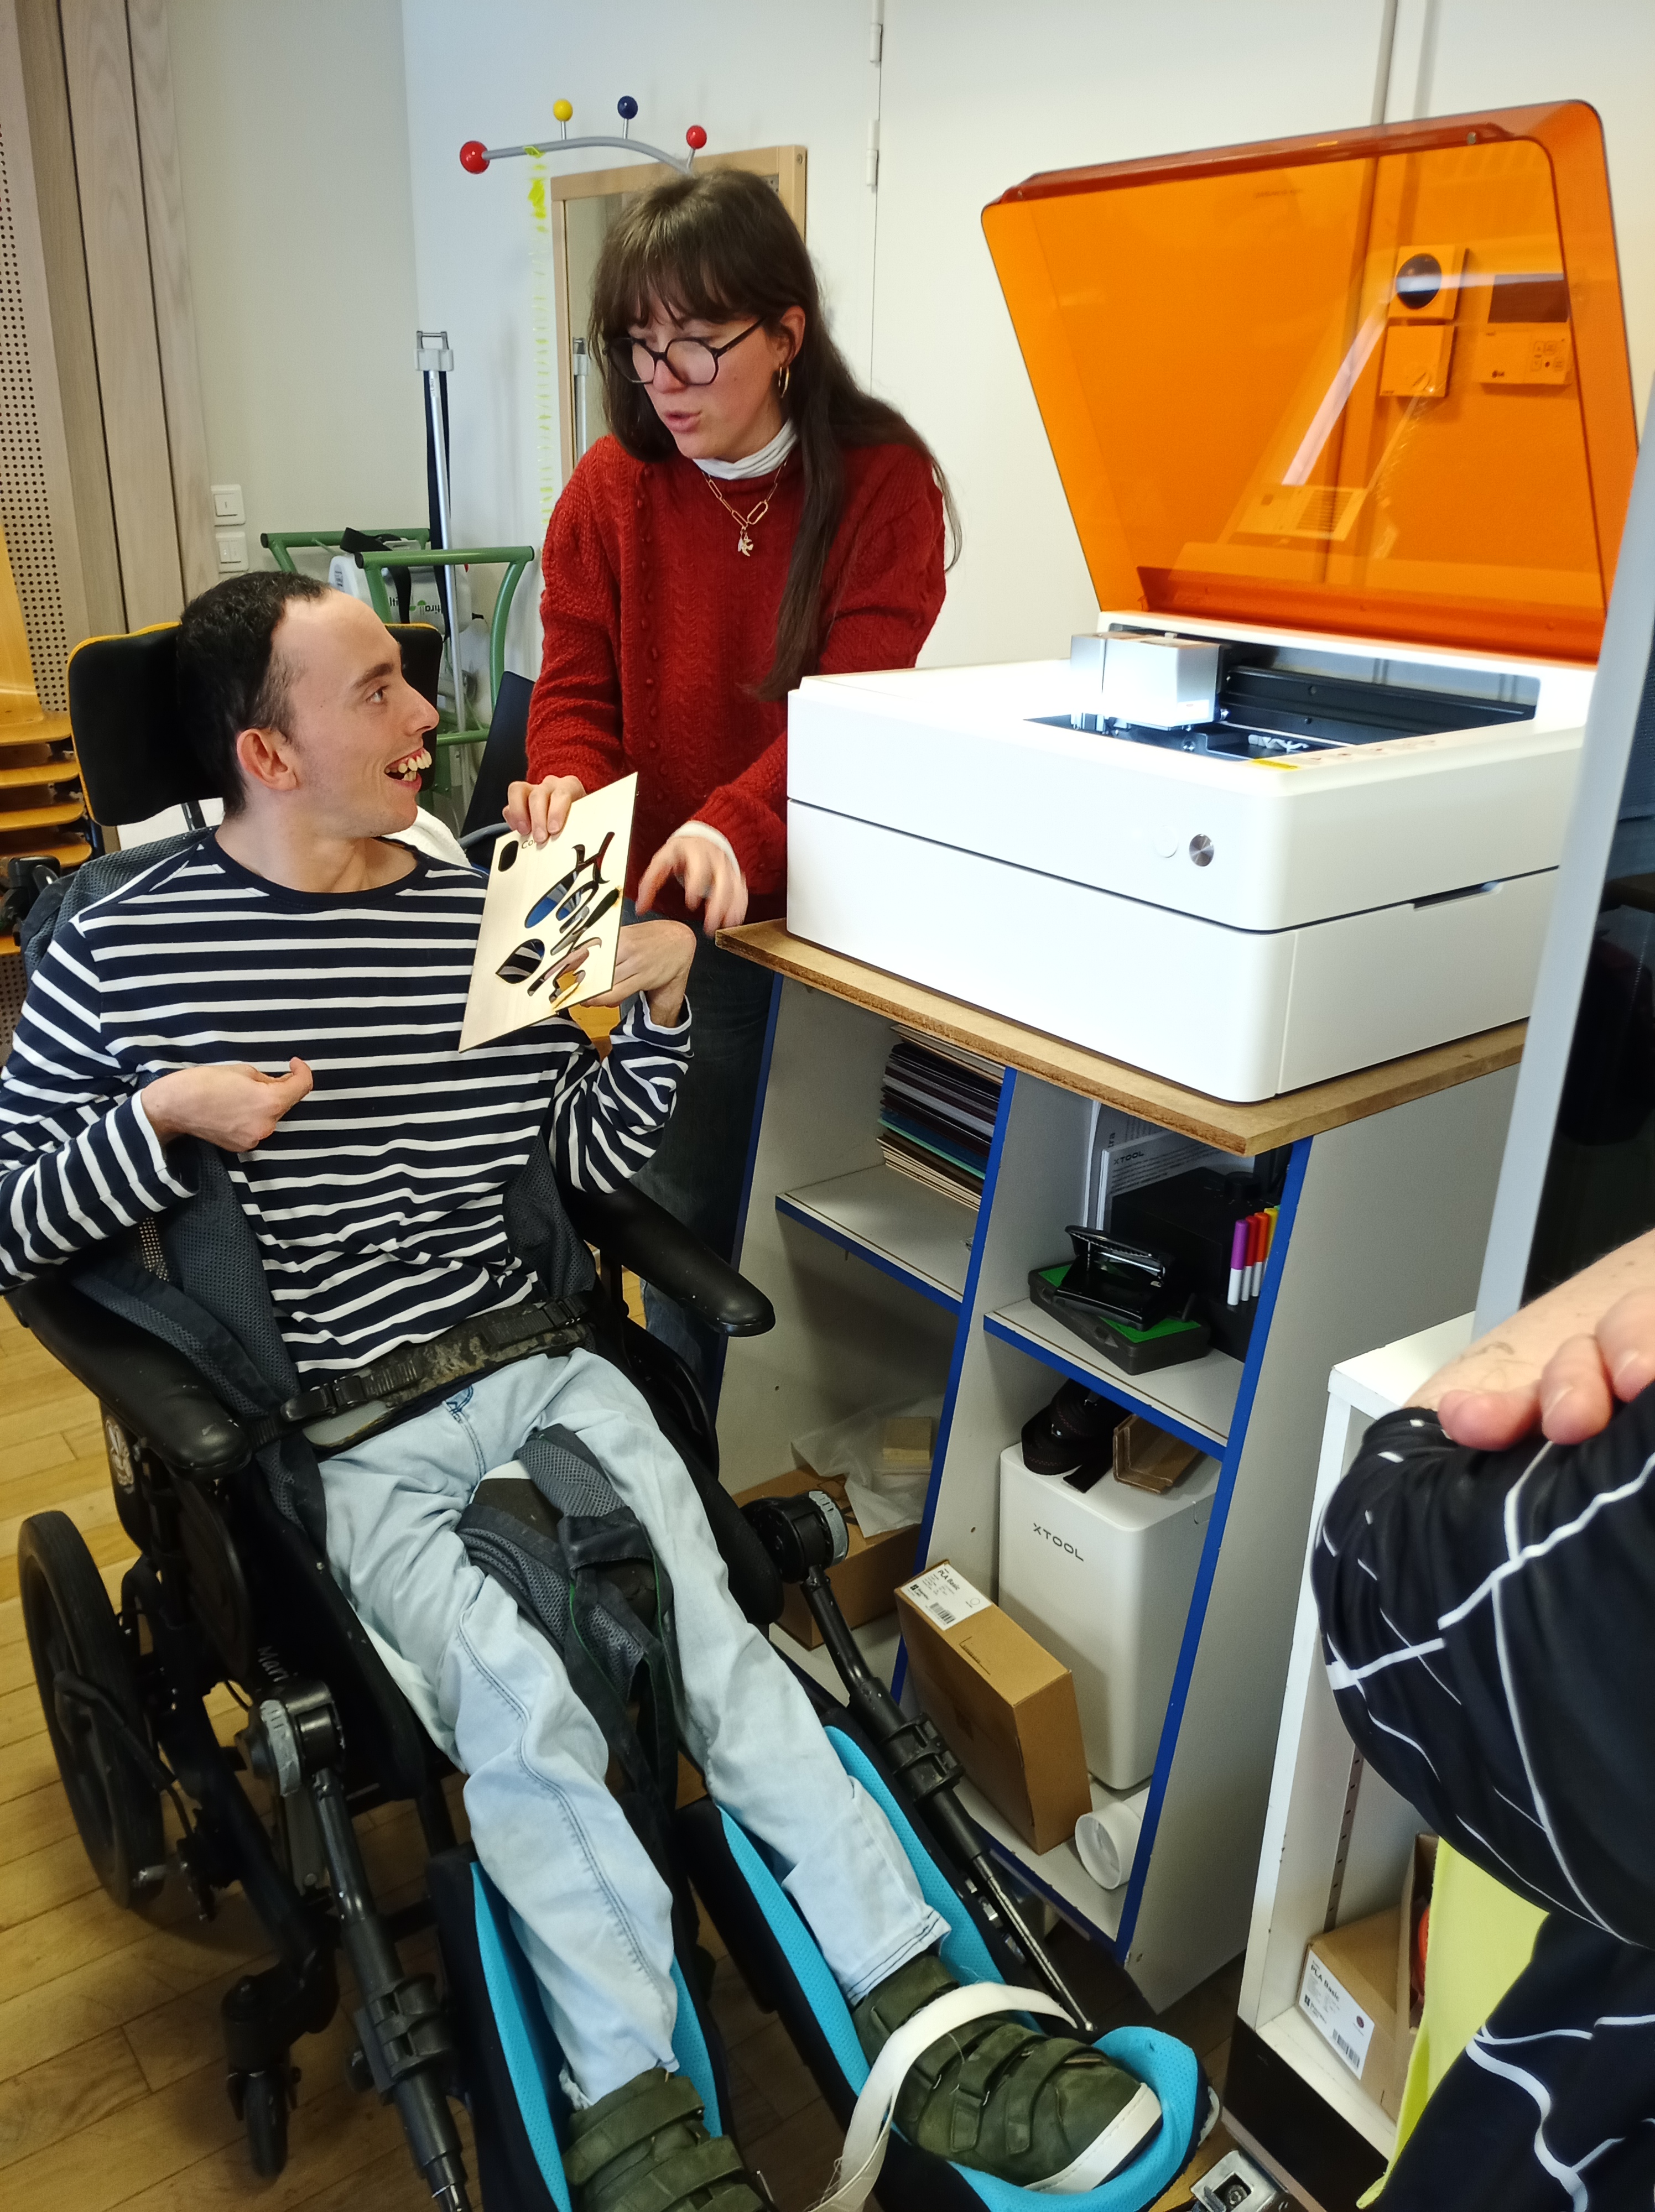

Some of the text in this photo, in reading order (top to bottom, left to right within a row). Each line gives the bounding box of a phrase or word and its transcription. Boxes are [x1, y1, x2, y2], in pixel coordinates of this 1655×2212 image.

[522, 840, 535, 849] Co
[1113, 1151, 1144, 1165] XTOOL
[1033, 1522, 1084, 1562] XTOOL
[938, 1569, 949, 1580] PLA
[1310, 1964, 1323, 1982] PLA
[1324, 1980, 1340, 2002] Basic
